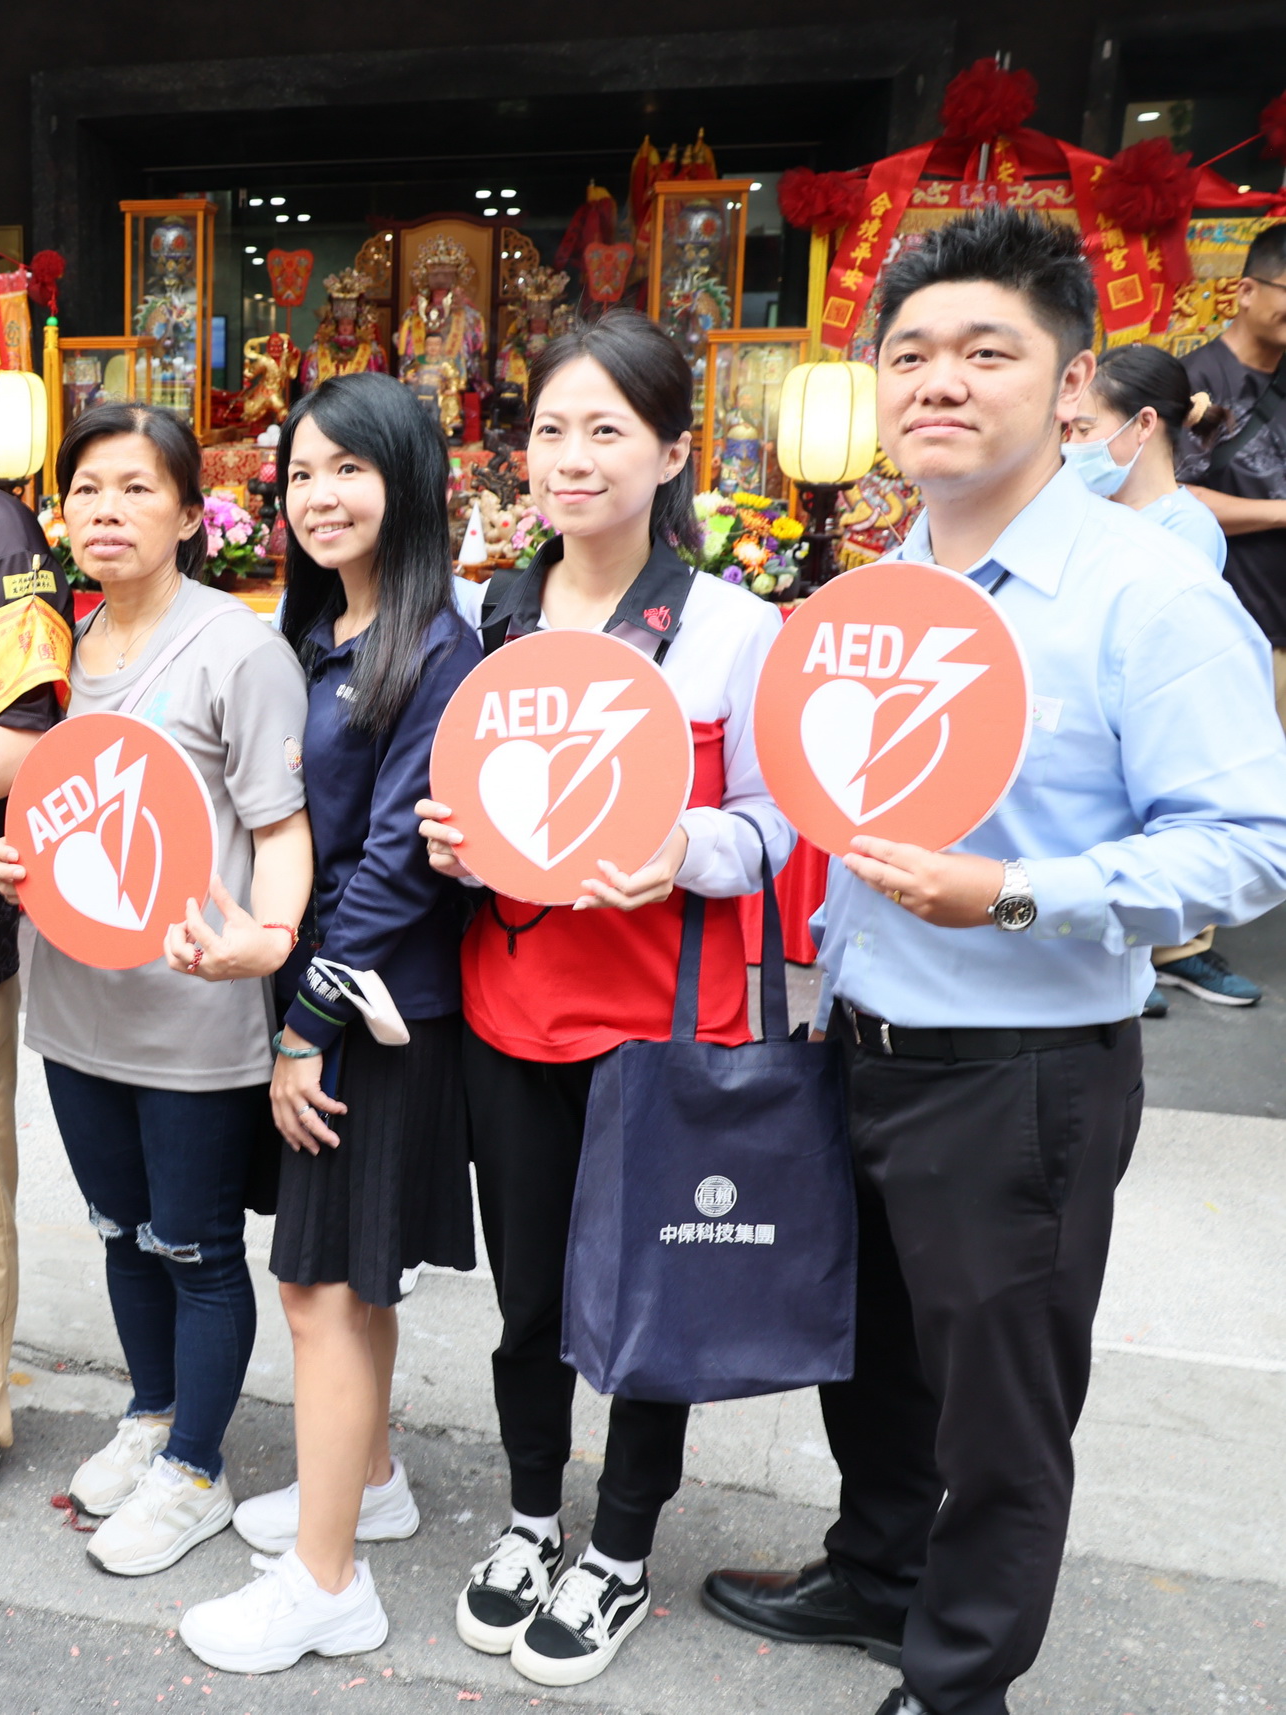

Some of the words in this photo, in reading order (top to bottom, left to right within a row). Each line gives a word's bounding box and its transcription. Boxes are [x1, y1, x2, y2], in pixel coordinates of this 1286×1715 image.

[839, 191, 893, 292] 合境平安
[802, 622, 904, 680] AED
[474, 686, 569, 740] AED
[26, 775, 96, 855] AED
[659, 1222, 776, 1246] 中保科技集團
